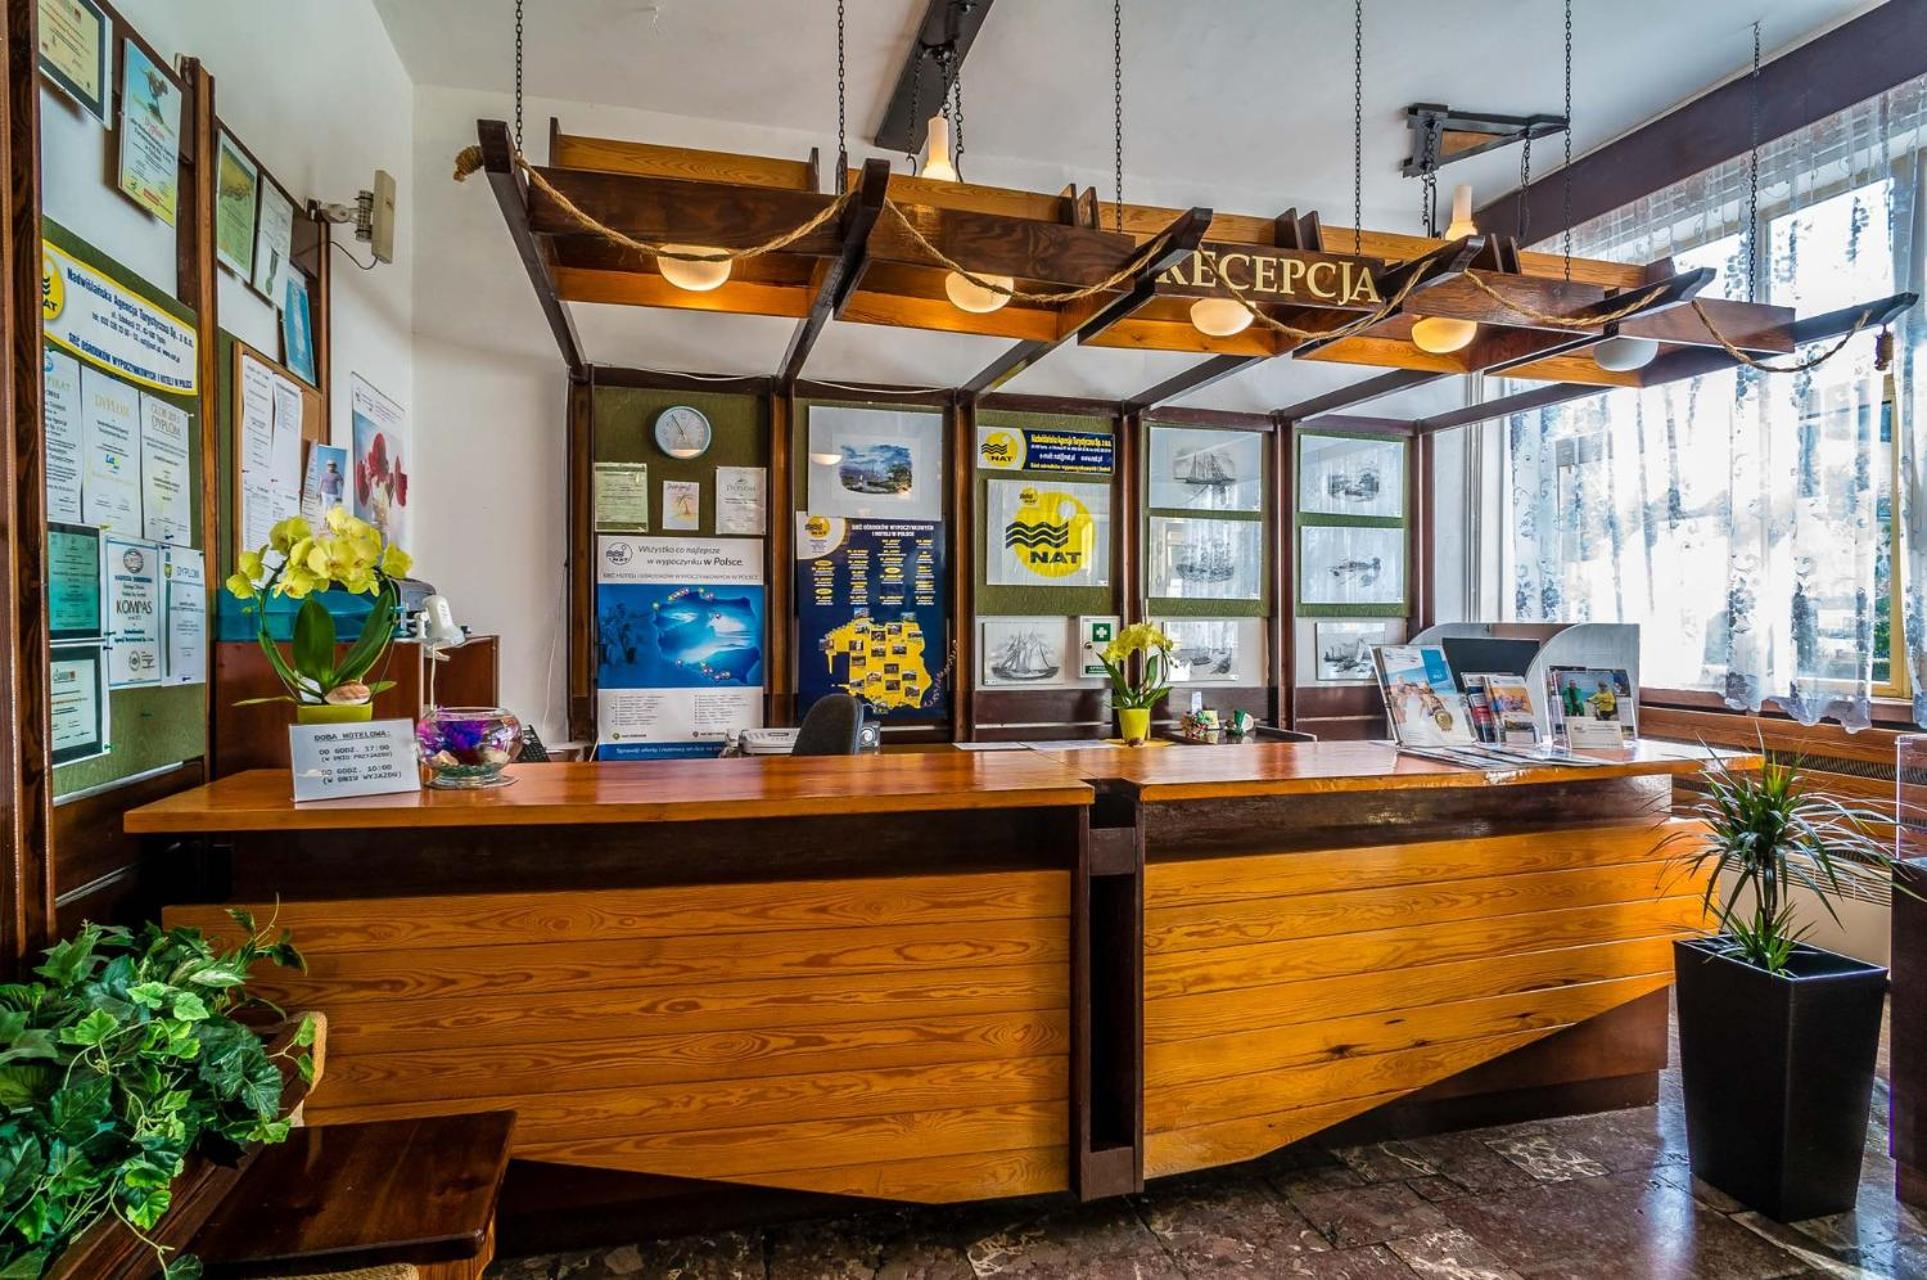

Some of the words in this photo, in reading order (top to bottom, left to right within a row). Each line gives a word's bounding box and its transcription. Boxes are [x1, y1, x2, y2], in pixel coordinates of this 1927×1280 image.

[44, 298, 57, 312] AT
[638, 545, 674, 554] Wszystko
[685, 546, 720, 555] najlepsze
[655, 558, 702, 567] wypoczynku
[1030, 551, 1082, 564] NAT
[116, 599, 153, 614] KOMPAS
[314, 732, 337, 742] DOBA
[342, 729, 391, 740] HOTELOWA:
[334, 746, 359, 754] GODZ.
[365, 744, 390, 752] 17:00
[336, 767, 361, 775] GODZ.
[367, 764, 392, 772] 10:00
[323, 777, 333, 785] (W
[338, 775, 359, 783] DNIU
[363, 771, 402, 781] WYJAZDU)
